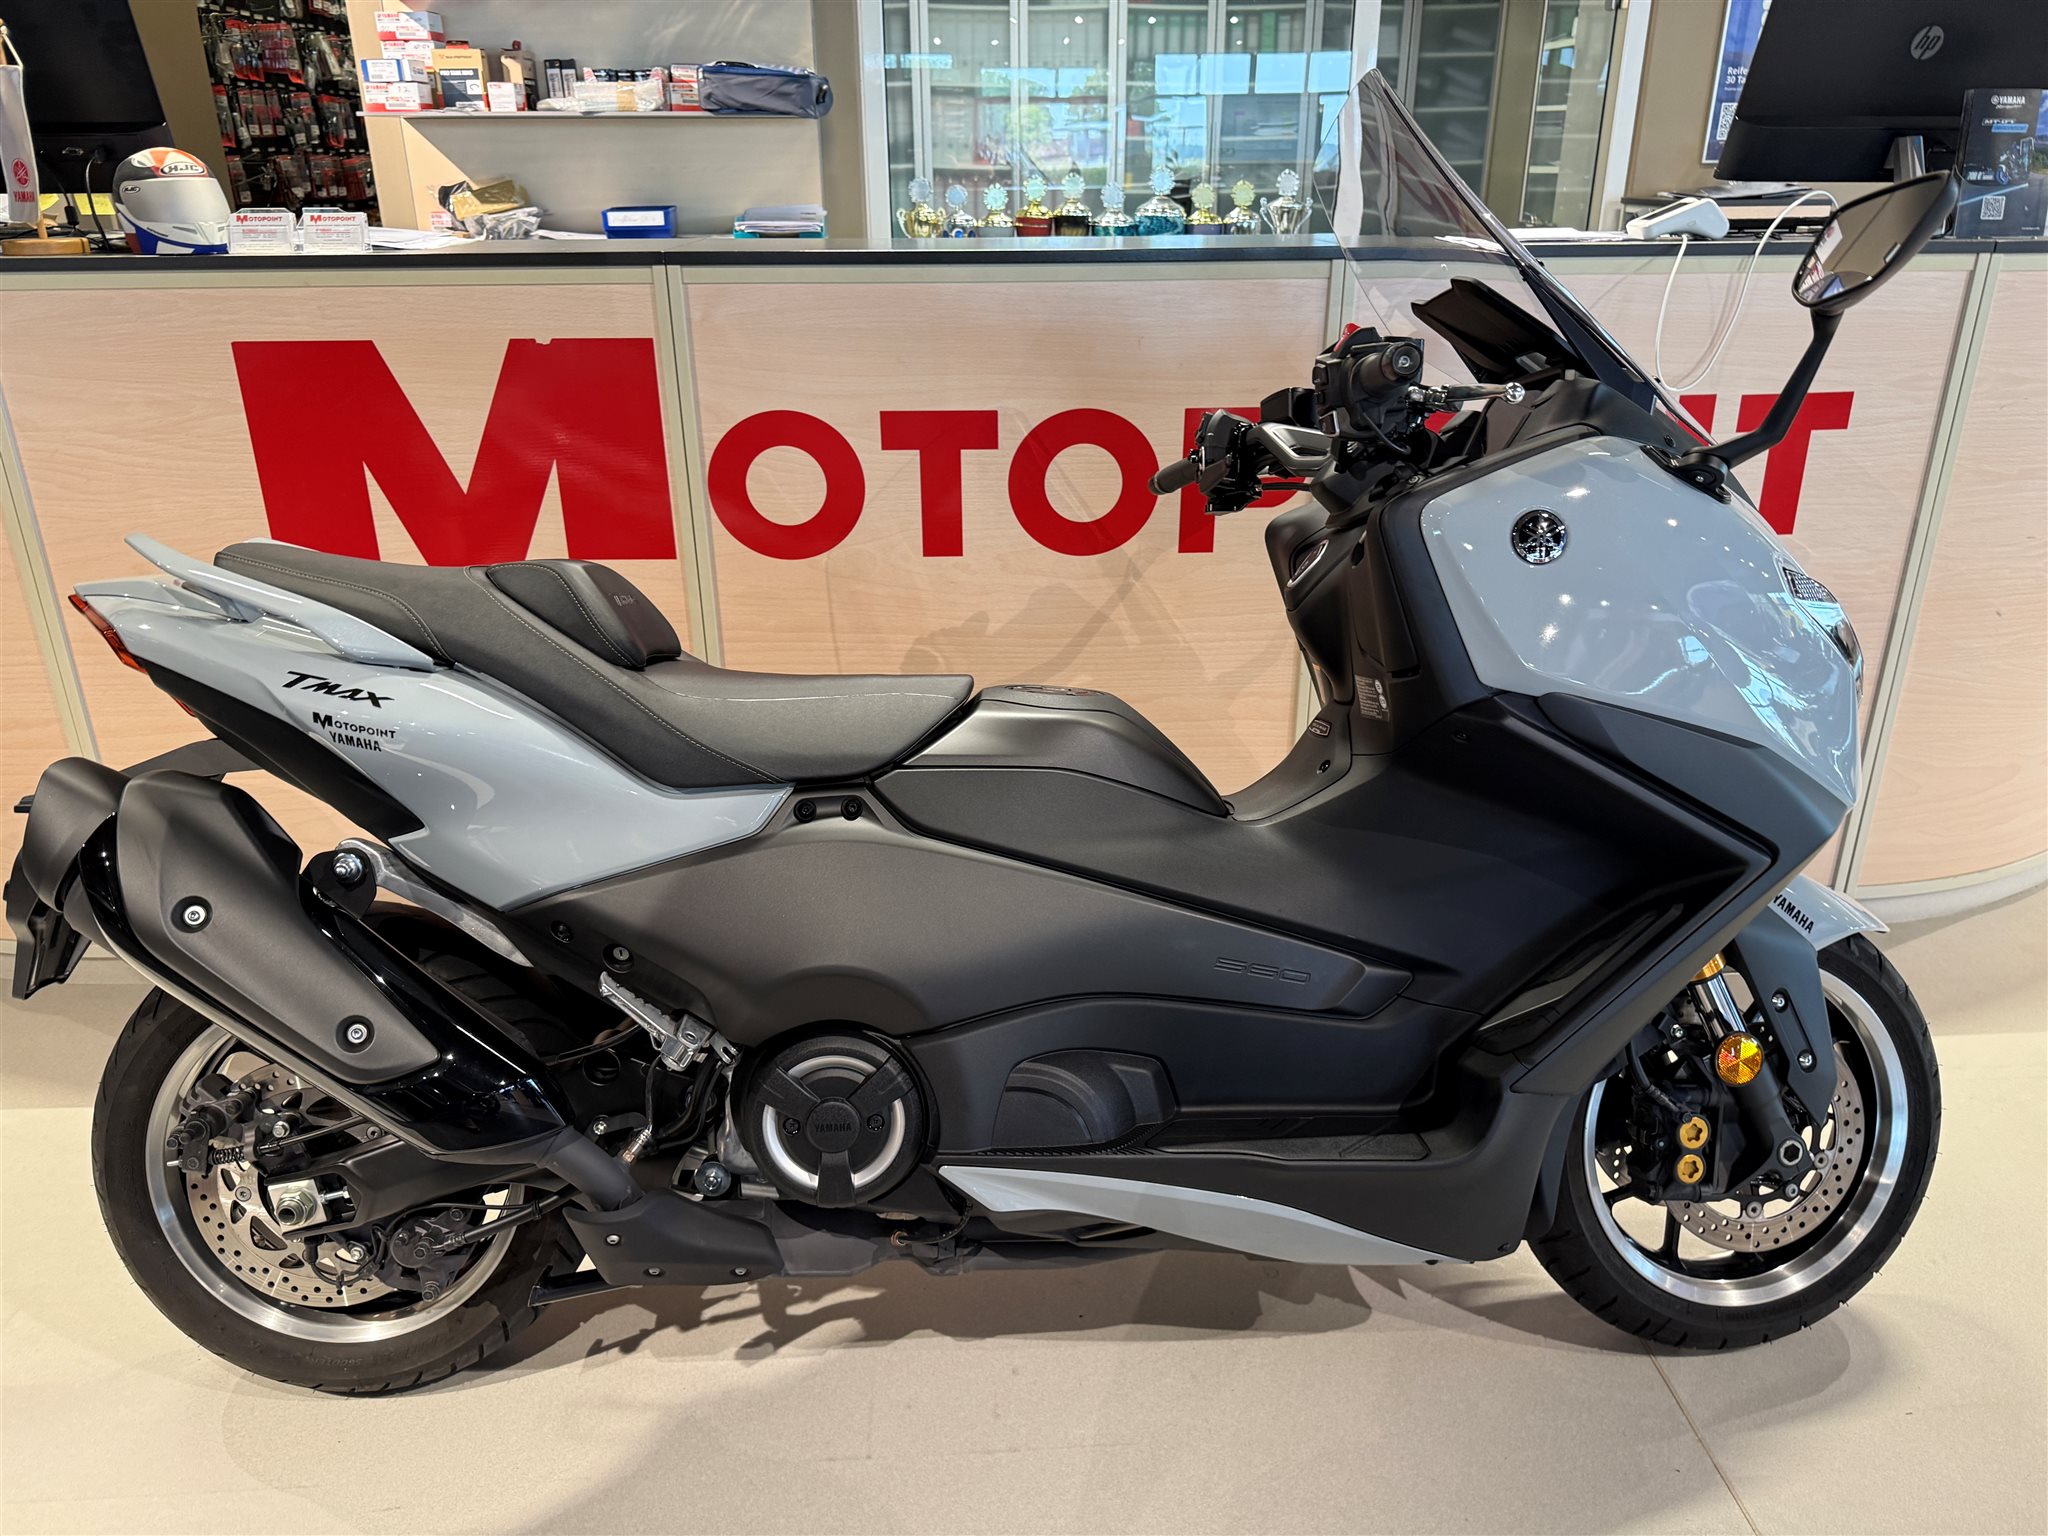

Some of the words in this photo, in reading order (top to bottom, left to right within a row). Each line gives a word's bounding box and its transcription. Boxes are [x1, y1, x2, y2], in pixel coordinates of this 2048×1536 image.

[1914, 26, 1941, 59] hp
[1725, 75, 1736, 84] 30
[2000, 95, 2026, 104] YAMAHA
[167, 164, 201, 174] HJC
[12, 190, 36, 202] YAMAHA
[236, 215, 282, 223] MOTOPOINT
[310, 215, 356, 223] MOTOPOINT
[282, 671, 394, 708] TMAX
[312, 711, 396, 738] MOTOPOINT
[329, 730, 381, 752] YAMAHA
[1773, 894, 1814, 934] YAMAHA
[815, 1123, 851, 1133] YAMAHA
